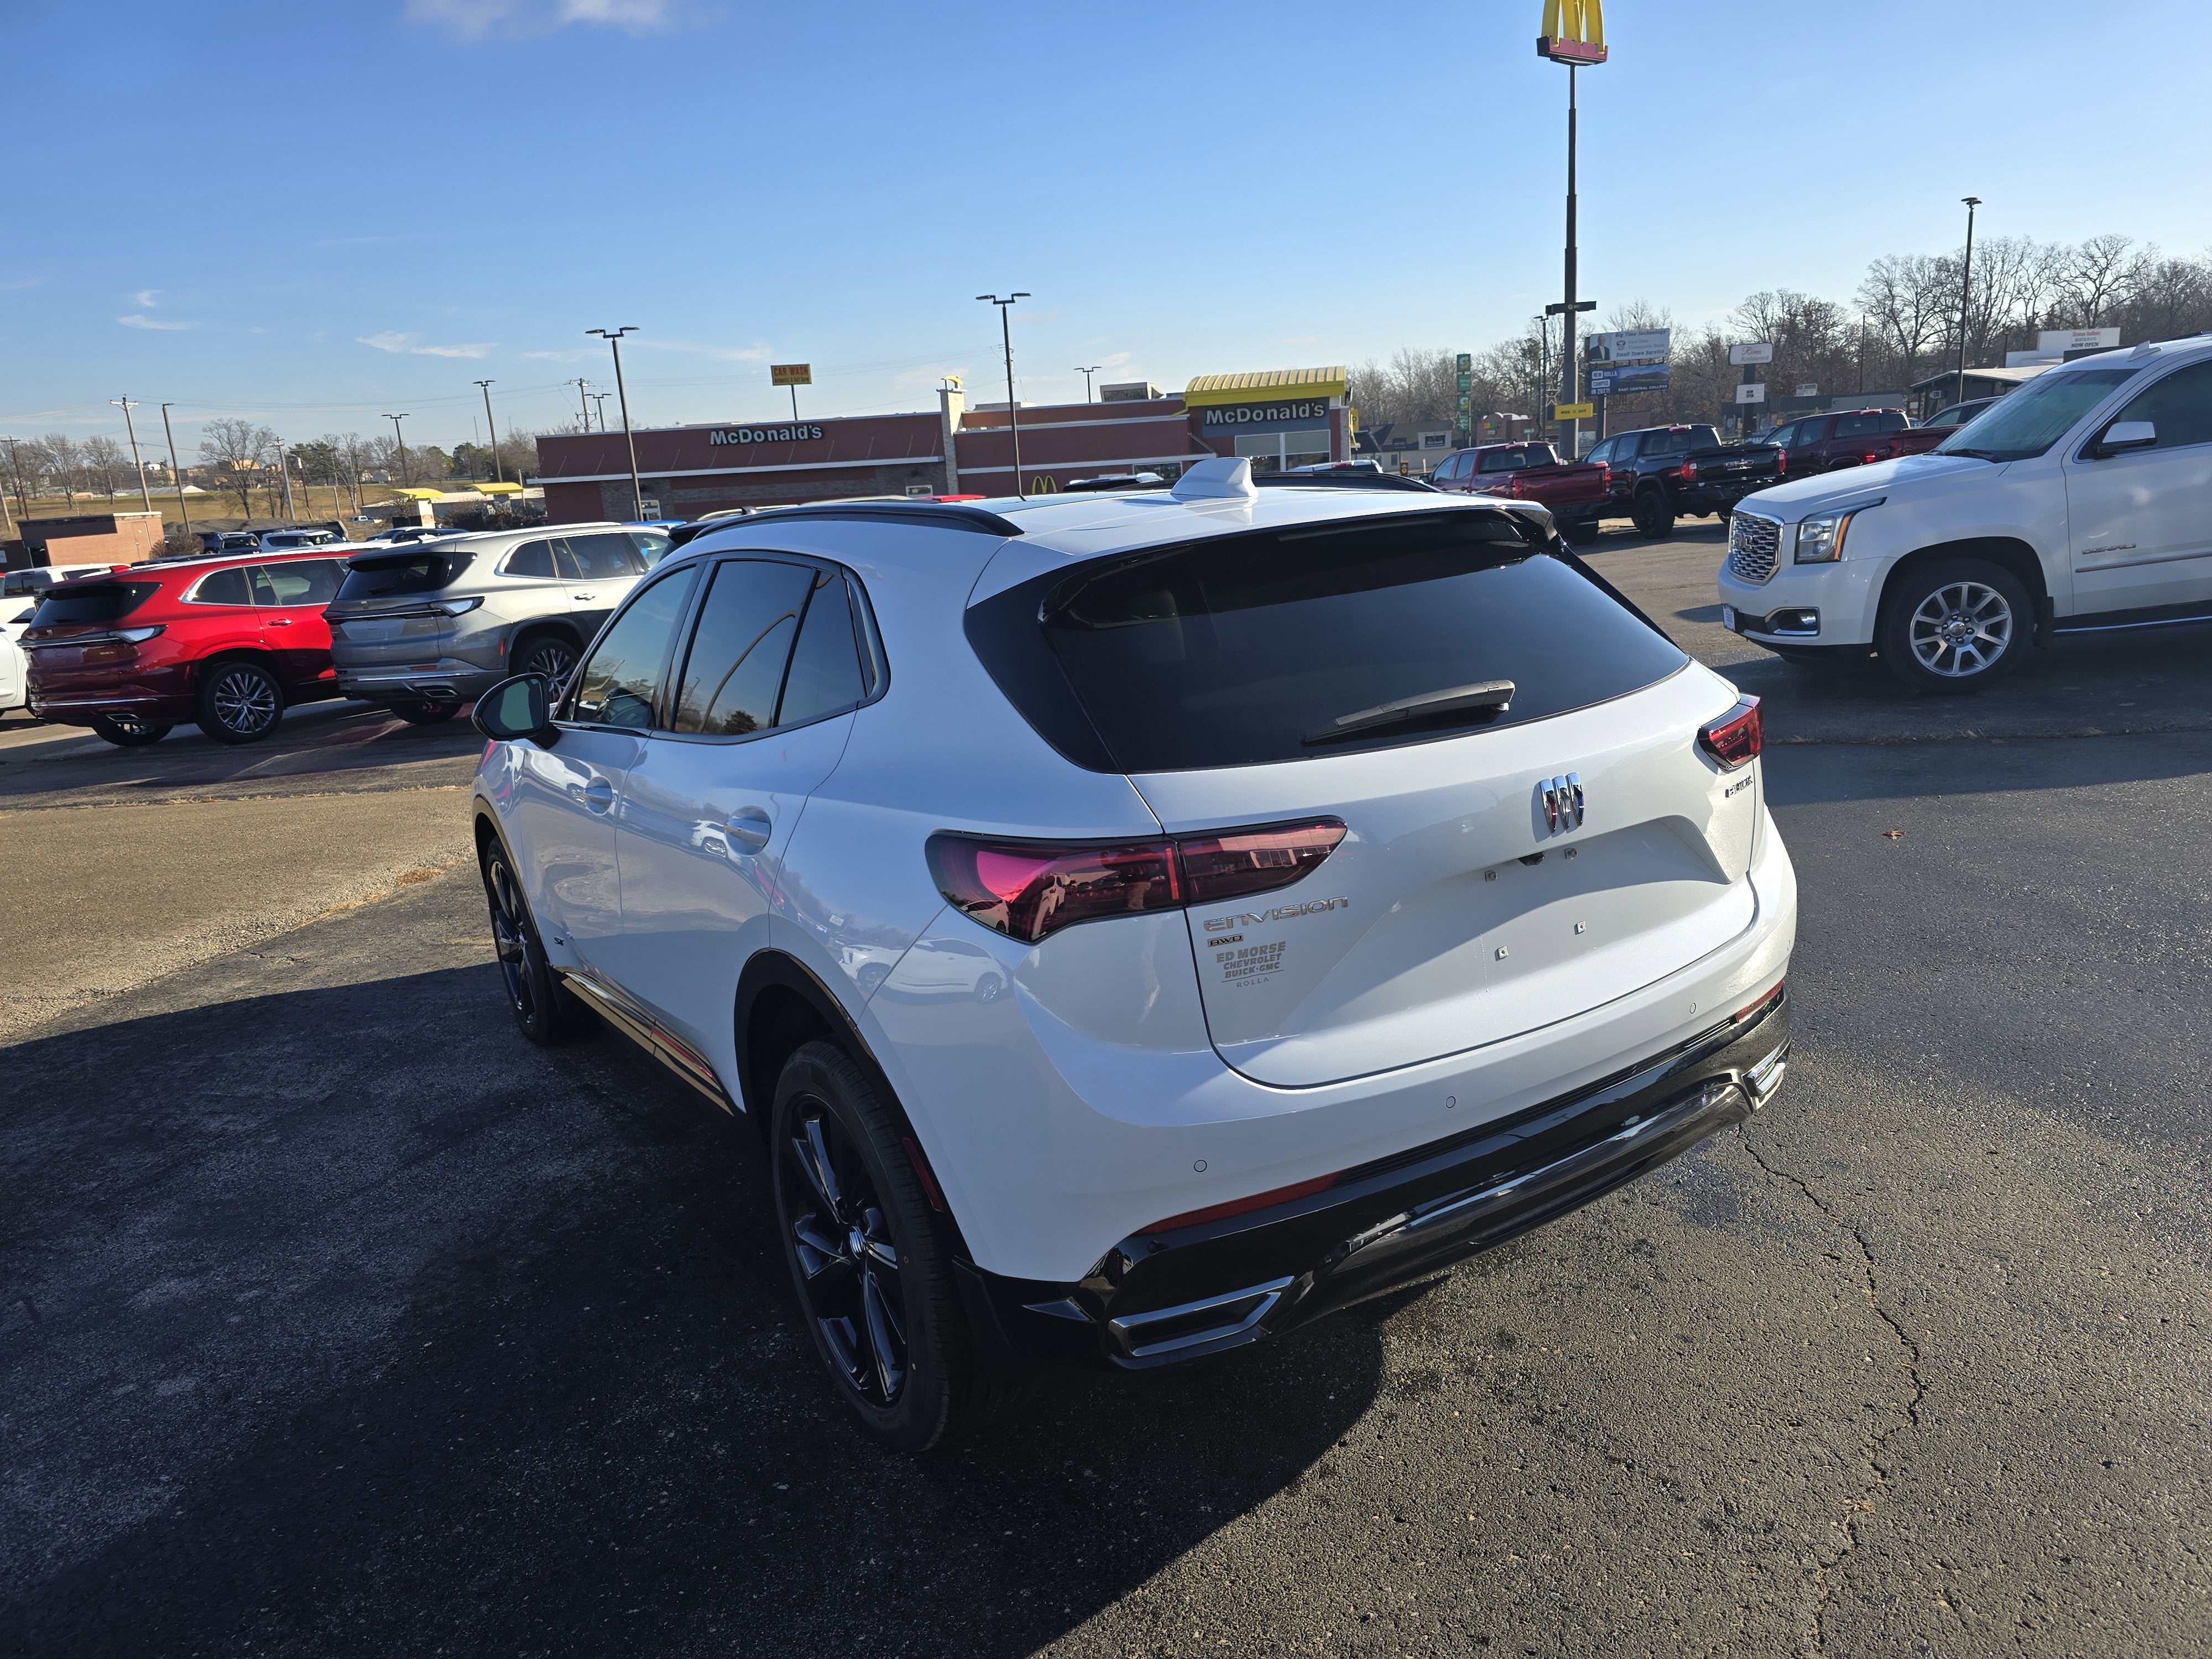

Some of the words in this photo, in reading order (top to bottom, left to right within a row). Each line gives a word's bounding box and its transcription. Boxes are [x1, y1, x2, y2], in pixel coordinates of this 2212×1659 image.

[774, 367, 786, 376] CAR
[789, 366, 808, 375] WASH
[1206, 403, 1324, 424] McDonald's
[710, 425, 822, 445] McDonald's
[1203, 896, 1348, 932] ENVISION
[1209, 935, 1242, 946] AWD
[1217, 951, 1234, 963] ED
[1238, 941, 1286, 958] MORSE
[1223, 953, 1281, 970] CHEVROLET
[1237, 977, 1269, 988] ROLLA
